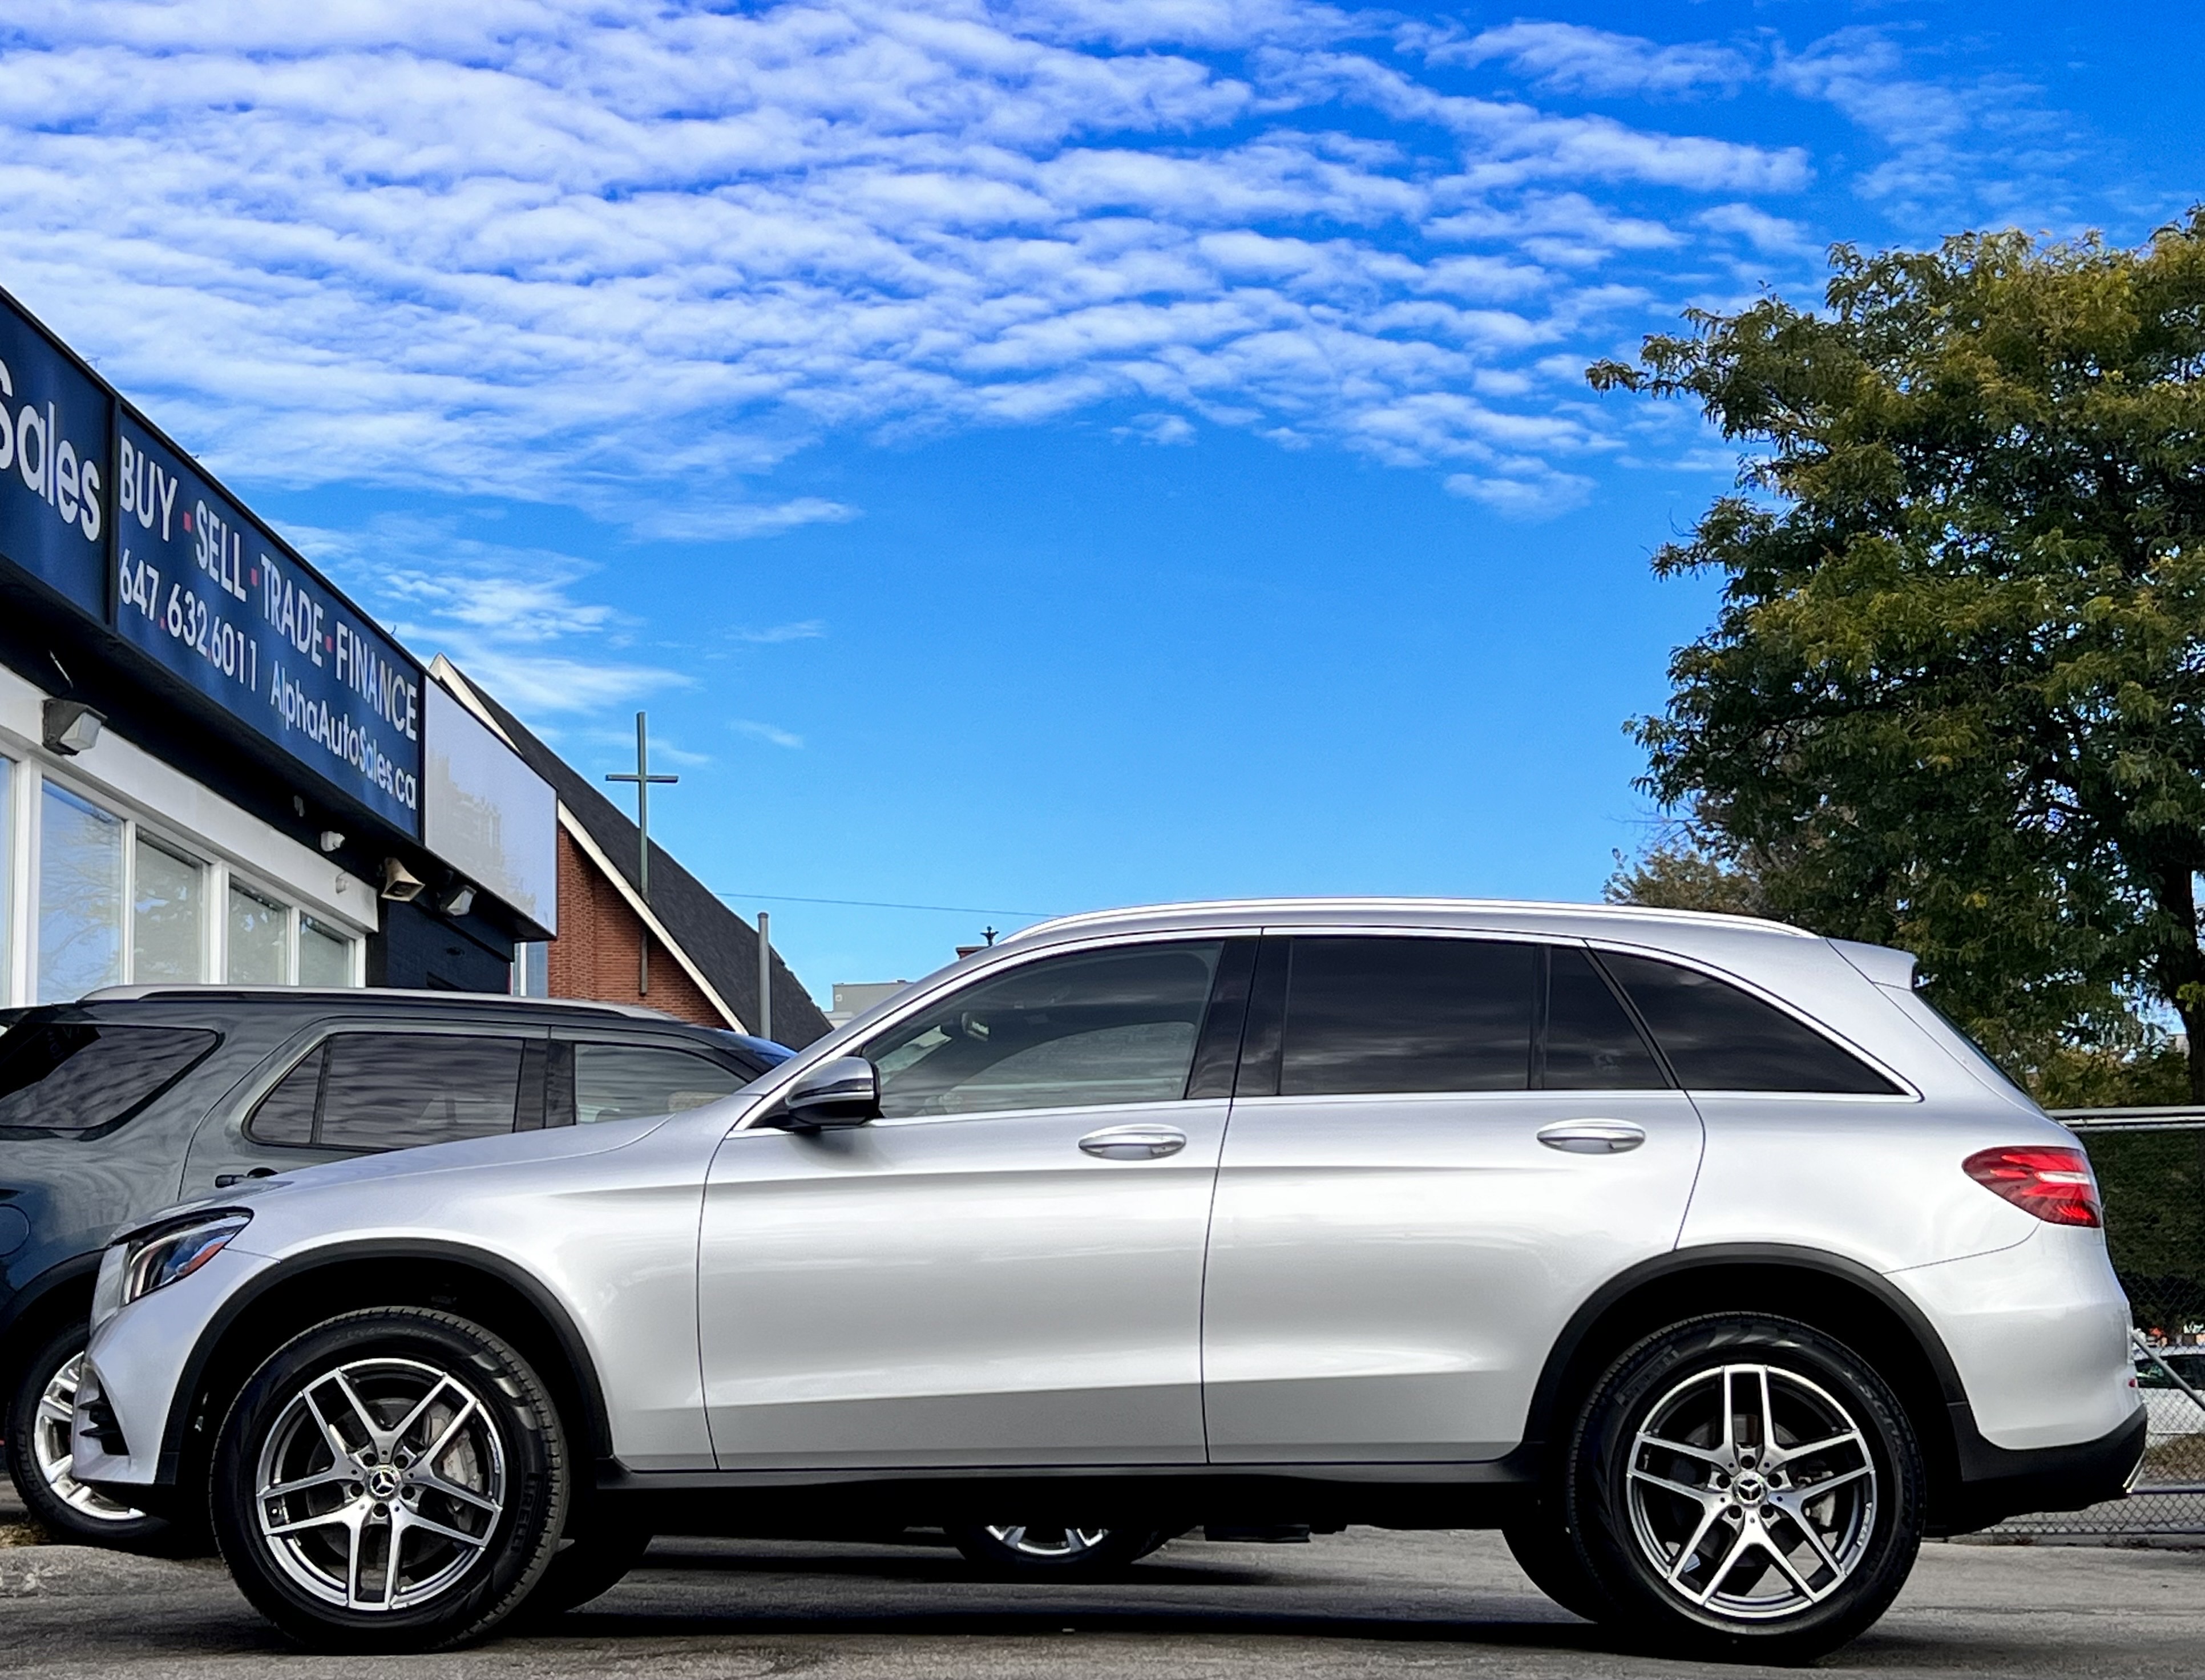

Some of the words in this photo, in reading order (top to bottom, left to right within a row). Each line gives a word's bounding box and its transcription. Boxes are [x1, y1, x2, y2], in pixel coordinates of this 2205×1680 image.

[0, 358, 101, 542] Sales
[120, 436, 177, 542] BUY
[196, 499, 247, 602] SELL
[261, 553, 324, 668] TRADE
[336, 621, 417, 741] FINANCE
[270, 660, 417, 810] AlphaAutoSales.ca
